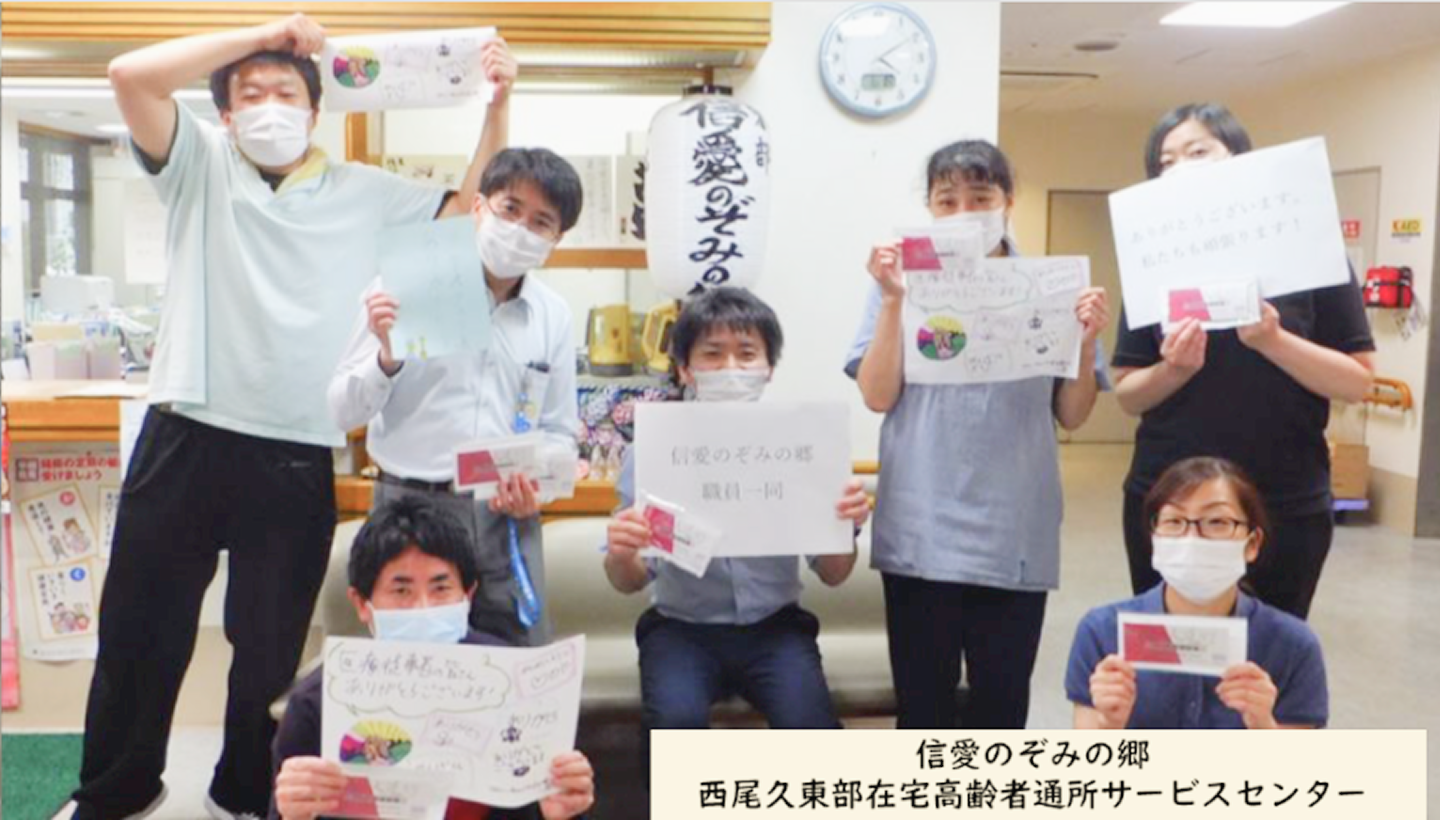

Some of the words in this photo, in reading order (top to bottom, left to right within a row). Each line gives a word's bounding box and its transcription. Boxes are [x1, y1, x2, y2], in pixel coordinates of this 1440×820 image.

[671, 444, 814, 467] 信愛のぞみの郷
[702, 481, 784, 501] 職員一同
